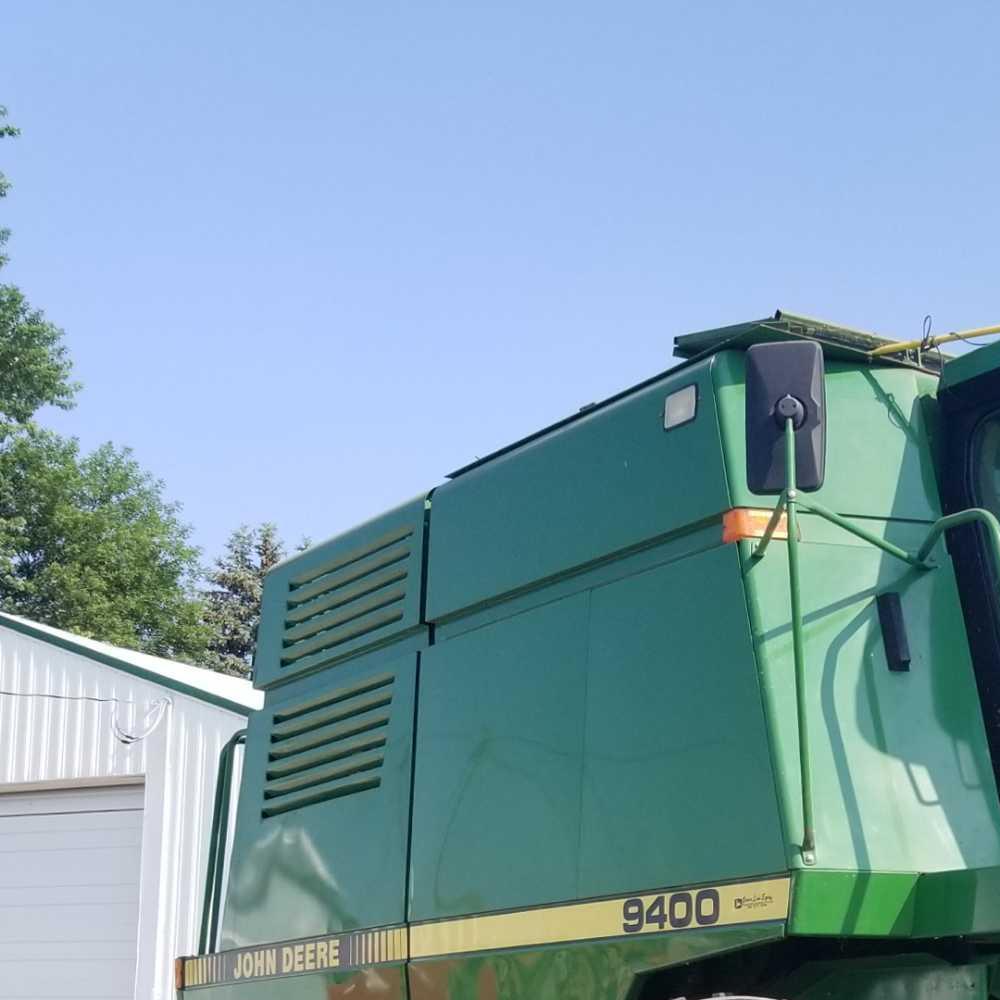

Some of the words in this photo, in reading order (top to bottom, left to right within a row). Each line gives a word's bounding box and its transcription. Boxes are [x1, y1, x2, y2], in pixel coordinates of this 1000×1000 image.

[623, 889, 719, 932] 9400
[234, 948, 276, 979] JOHN
[282, 939, 340, 973] DEERE
